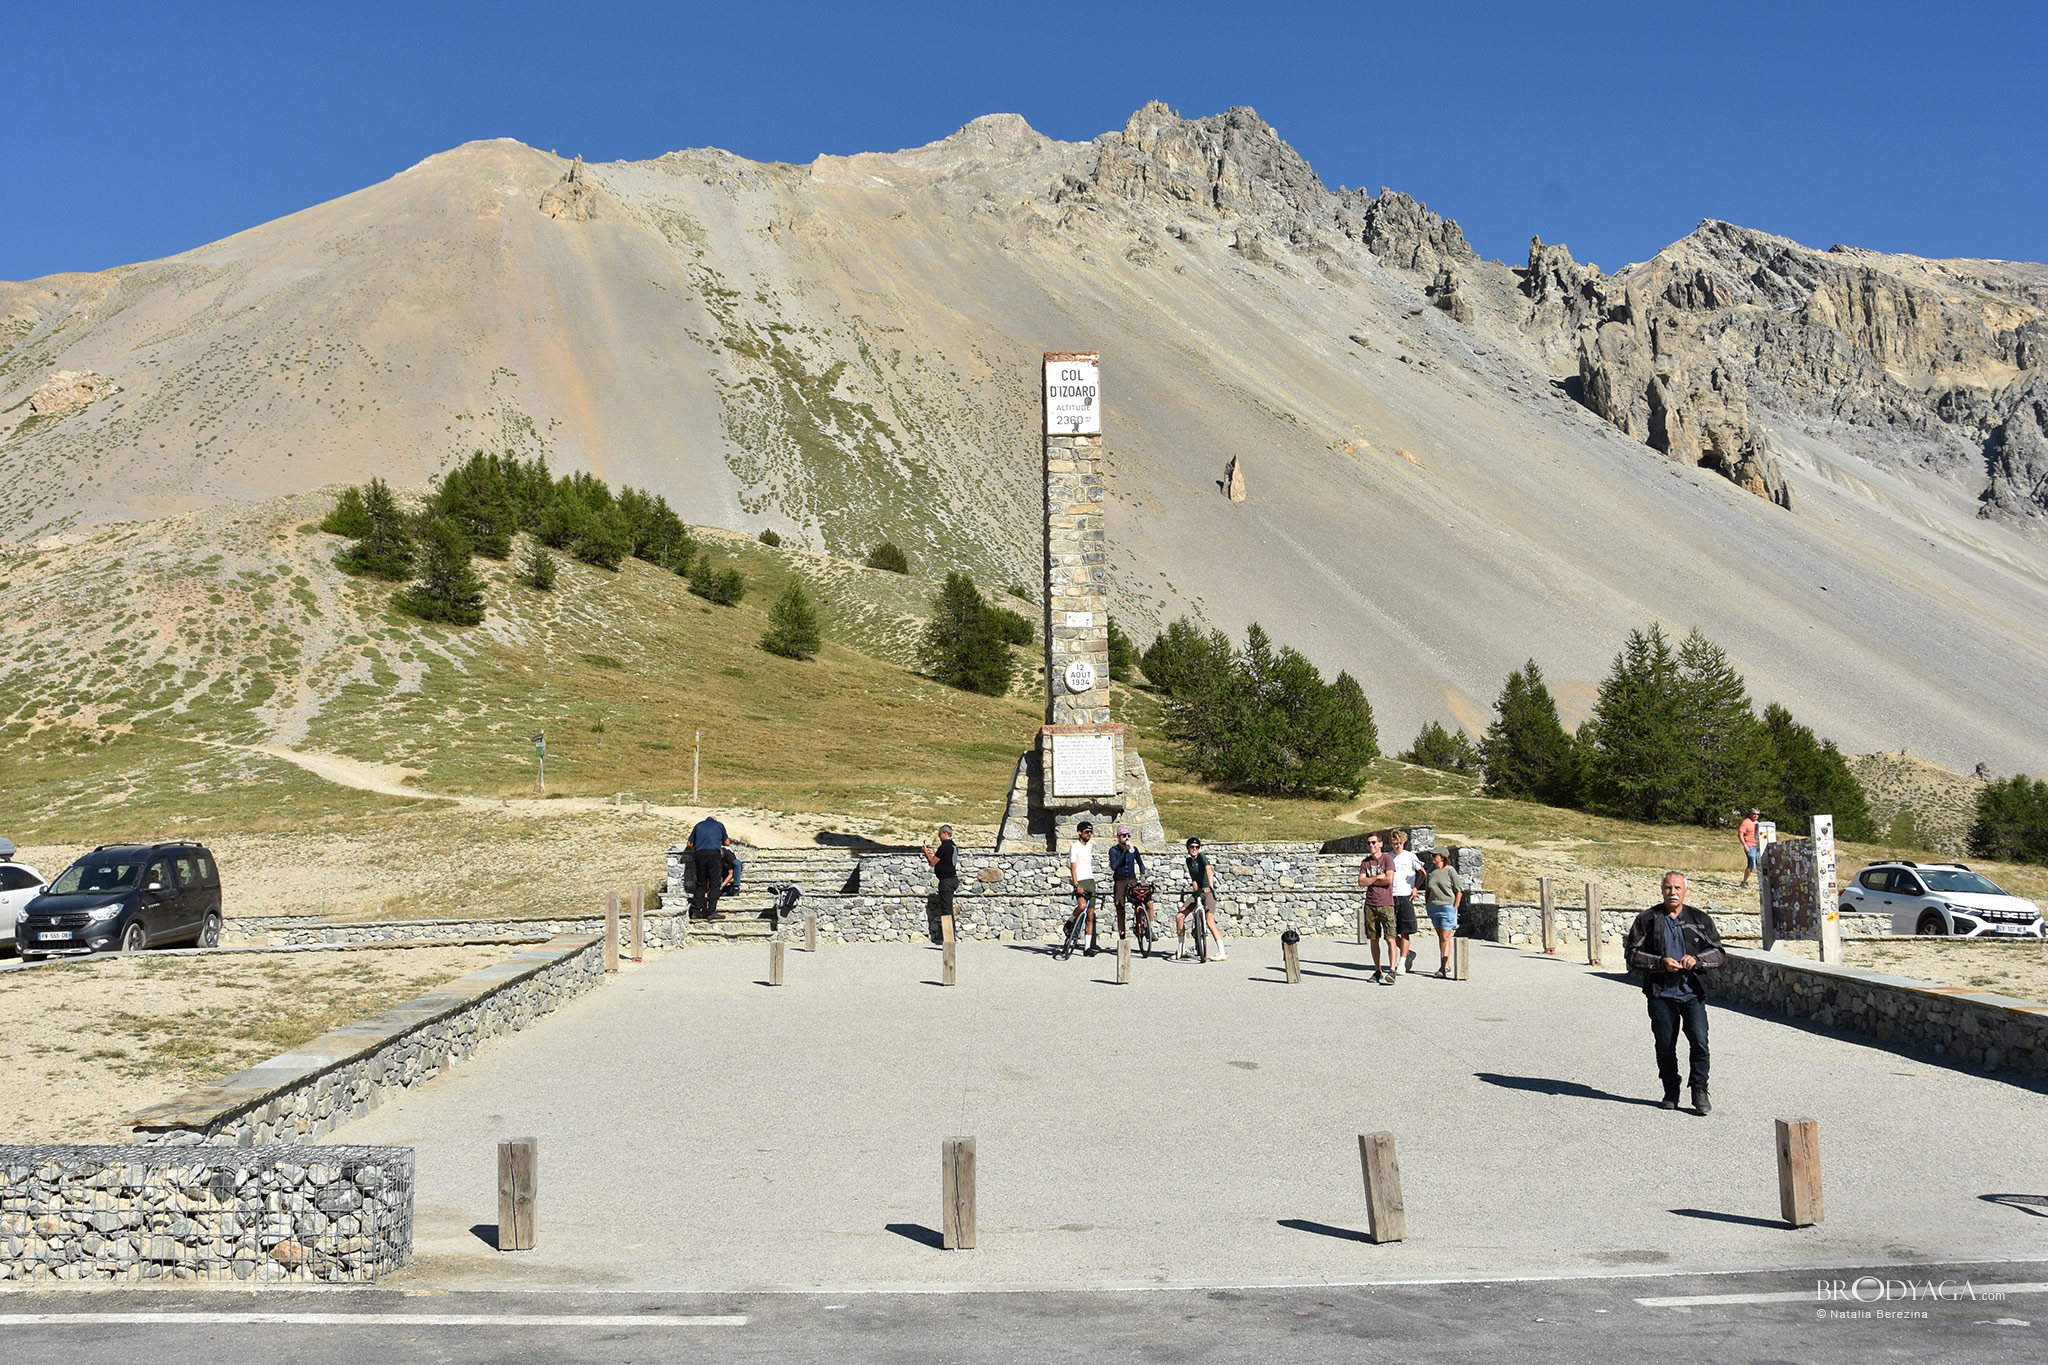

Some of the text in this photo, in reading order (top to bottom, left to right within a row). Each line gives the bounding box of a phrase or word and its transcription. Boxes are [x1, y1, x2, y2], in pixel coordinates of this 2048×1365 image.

[1061, 369, 1084, 381] COL
[1050, 385, 1096, 397] D'IZOARD
[1056, 415, 1084, 425] 2360
